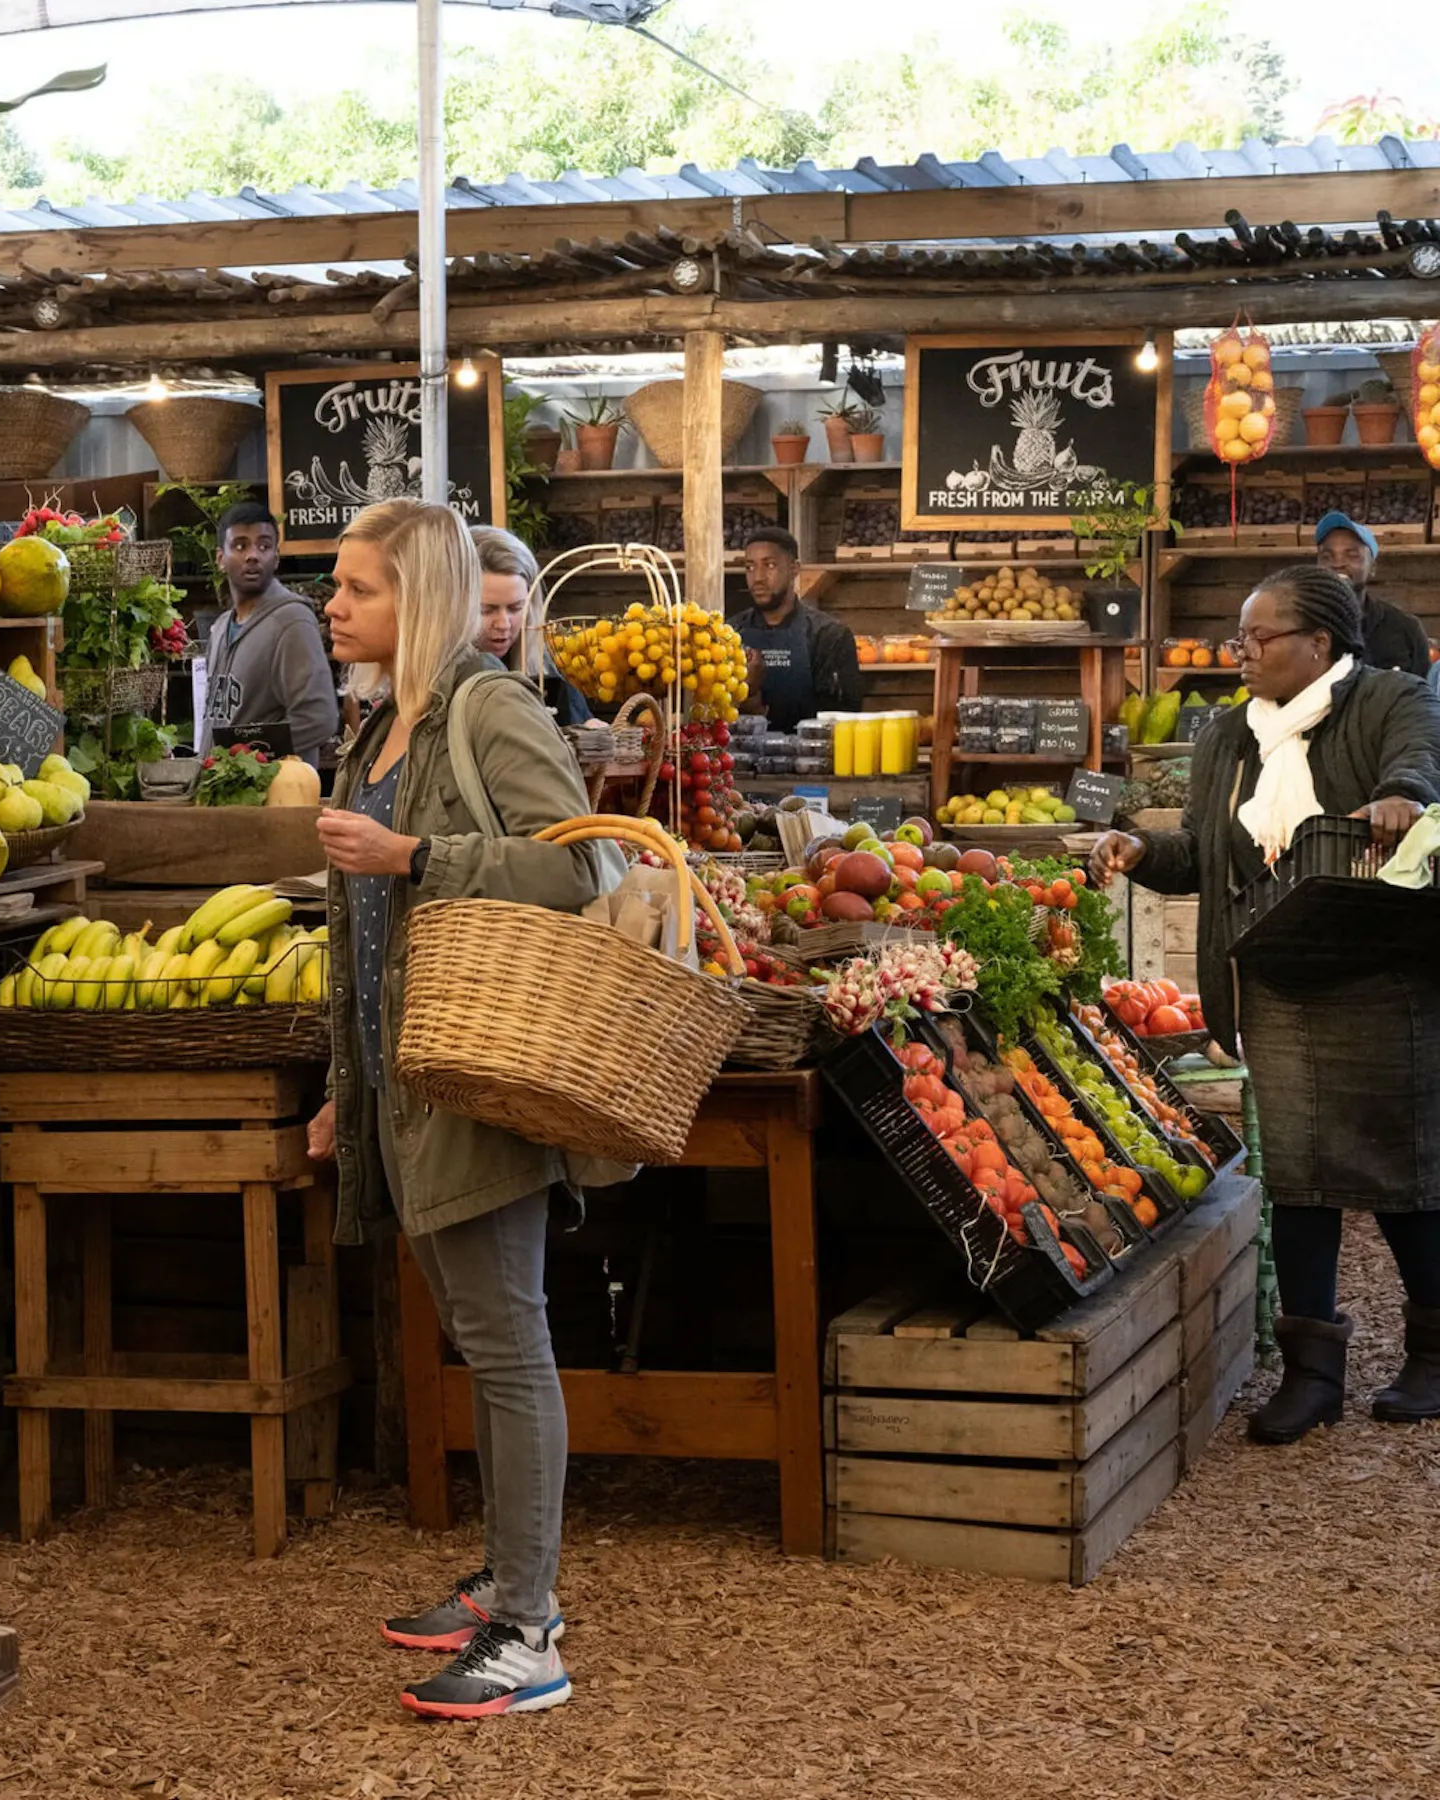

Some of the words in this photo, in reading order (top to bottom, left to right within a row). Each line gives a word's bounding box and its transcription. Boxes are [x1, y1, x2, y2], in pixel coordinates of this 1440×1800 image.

[966, 350, 1115, 408] Fruits
[929, 491, 977, 508] FRESH
[982, 491, 1024, 508] FROM
[1030, 490, 1059, 507] THE
[289, 506, 337, 525] FRESH
[342, 505, 361, 523] FR
[449, 500, 480, 519] RM
[206, 674, 244, 723] AP
[1048, 708, 1079, 717] GRAPES
